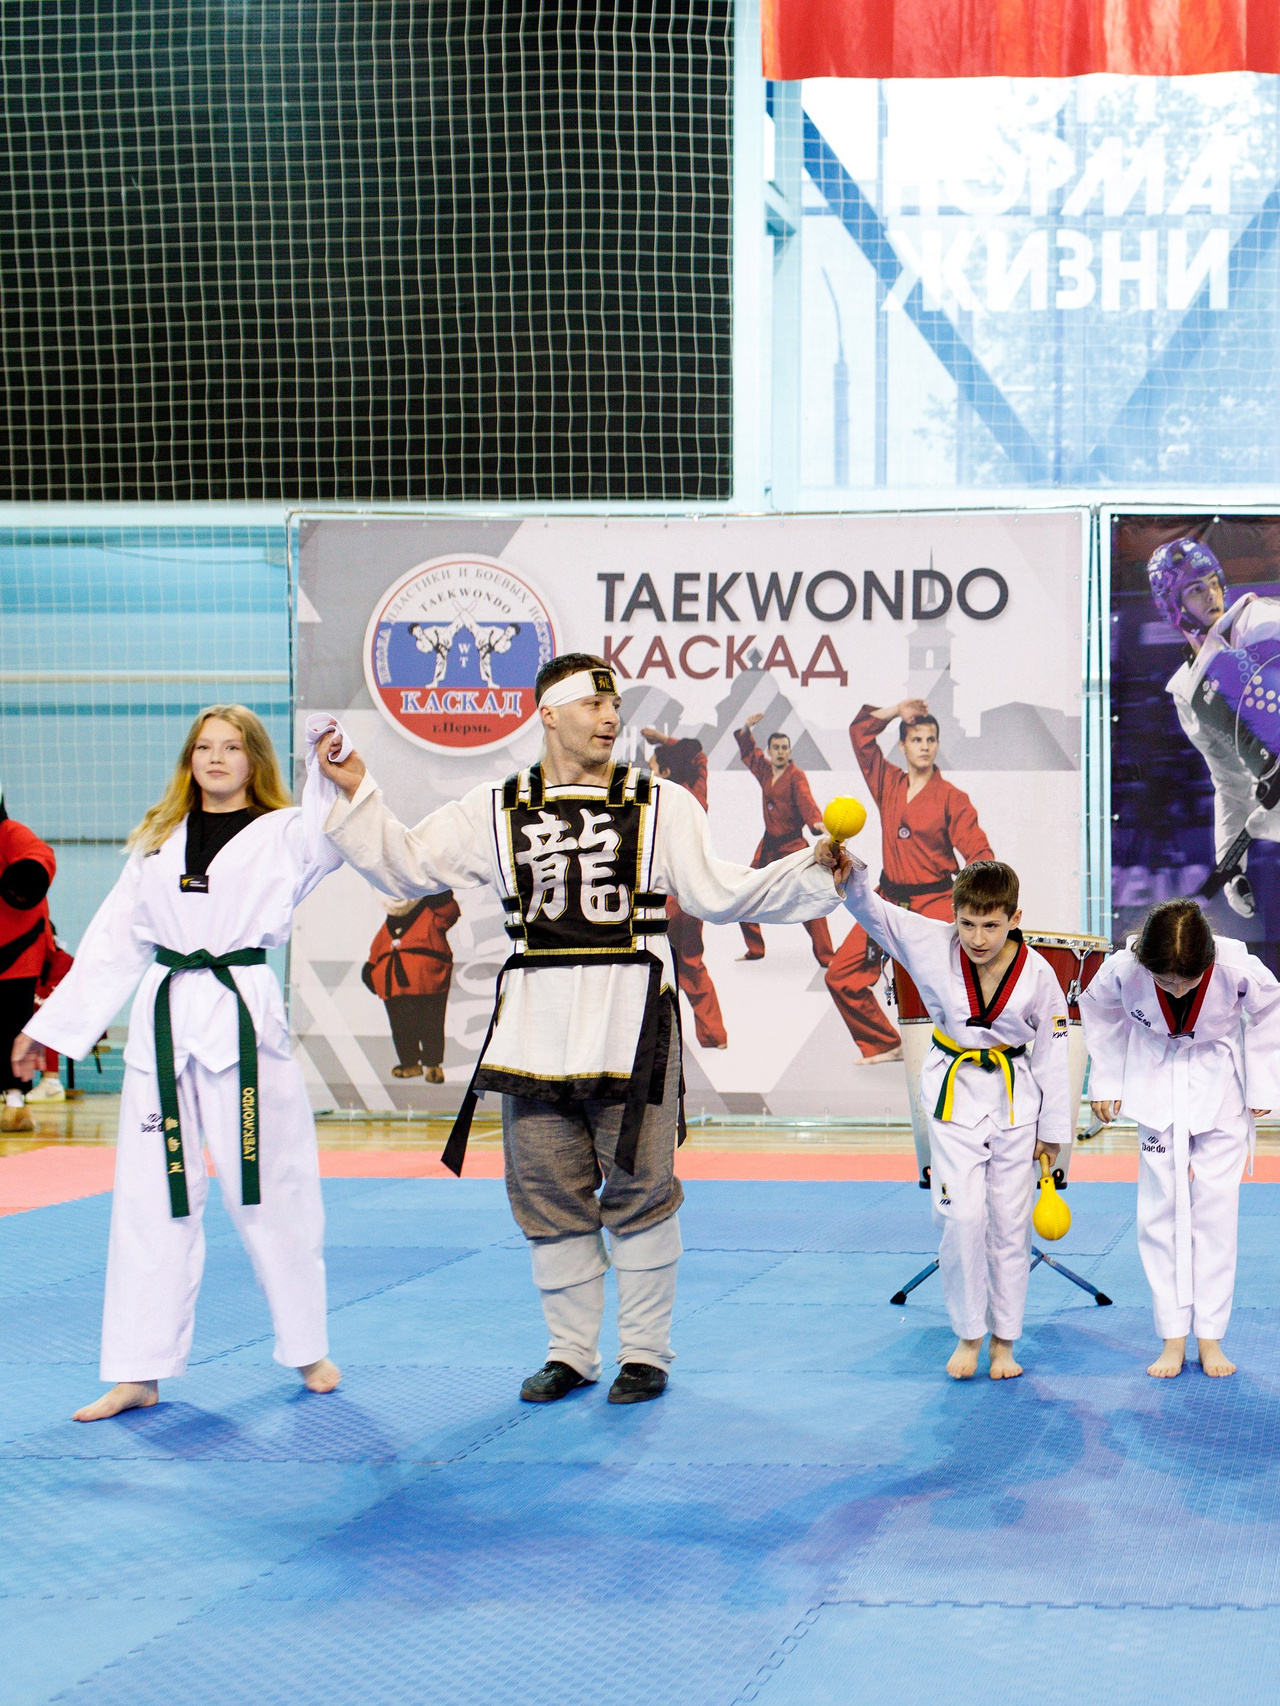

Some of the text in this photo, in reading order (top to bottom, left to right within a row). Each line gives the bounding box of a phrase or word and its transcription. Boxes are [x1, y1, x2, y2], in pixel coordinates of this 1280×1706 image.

[881, 229, 1229, 311] ЖИЗНИ
[420, 586, 512, 617] TAEKWONDO
[459, 567, 468, 579] И
[475, 568, 531, 605] БОЕВЫХ
[597, 567, 1009, 622] TAEKWONDO
[602, 634, 849, 687] КАСКАД
[400, 691, 523, 718] КАСКАД
